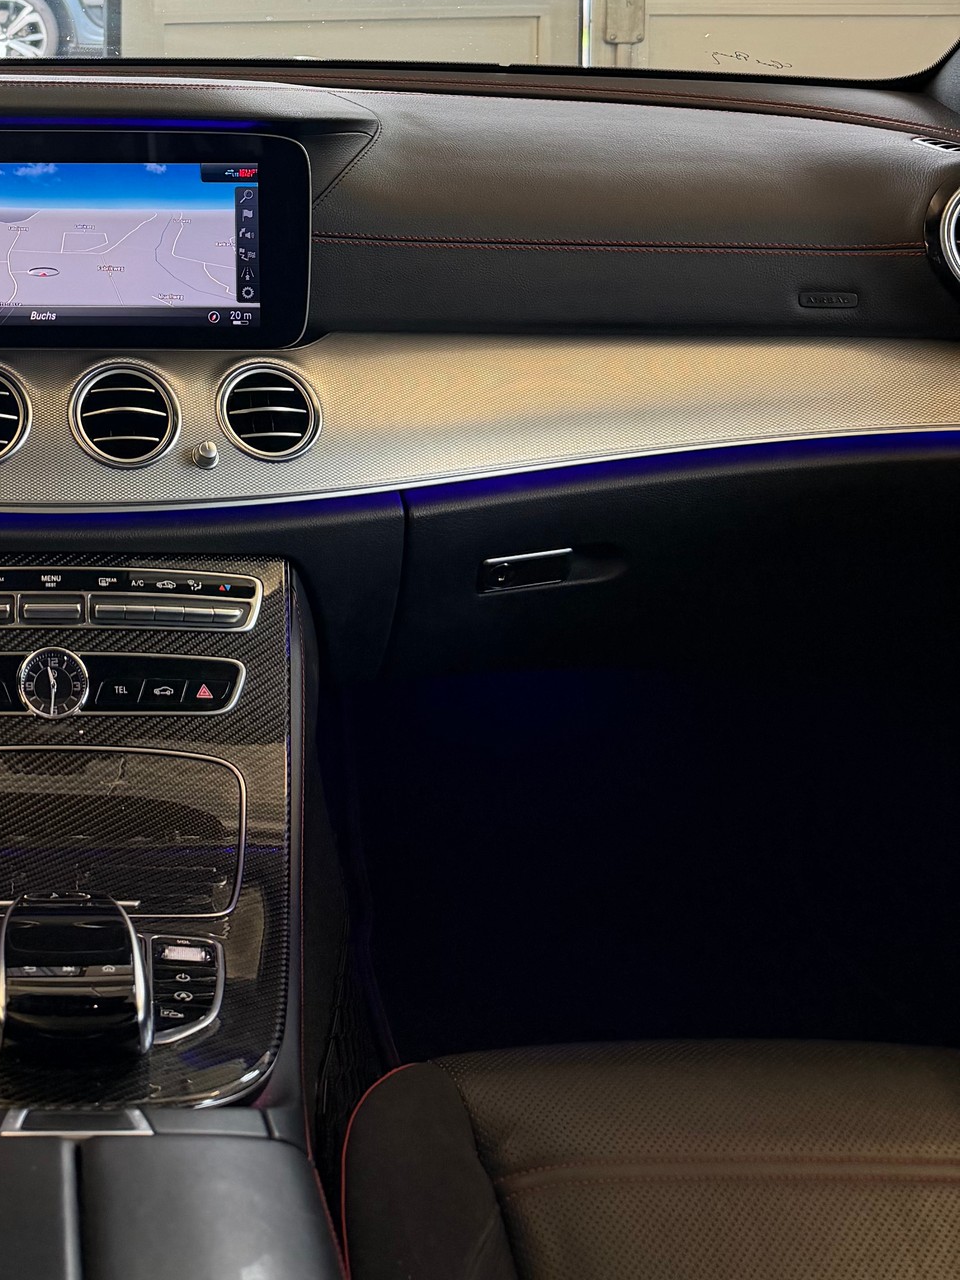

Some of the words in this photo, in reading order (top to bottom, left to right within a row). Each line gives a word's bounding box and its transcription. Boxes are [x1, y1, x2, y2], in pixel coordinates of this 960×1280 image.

[30, 311, 57, 321] Buchs
[230, 311, 241, 320] 20
[244, 312, 252, 320] m
[73, 682, 80, 691] 3
[114, 686, 128, 694] TEL
